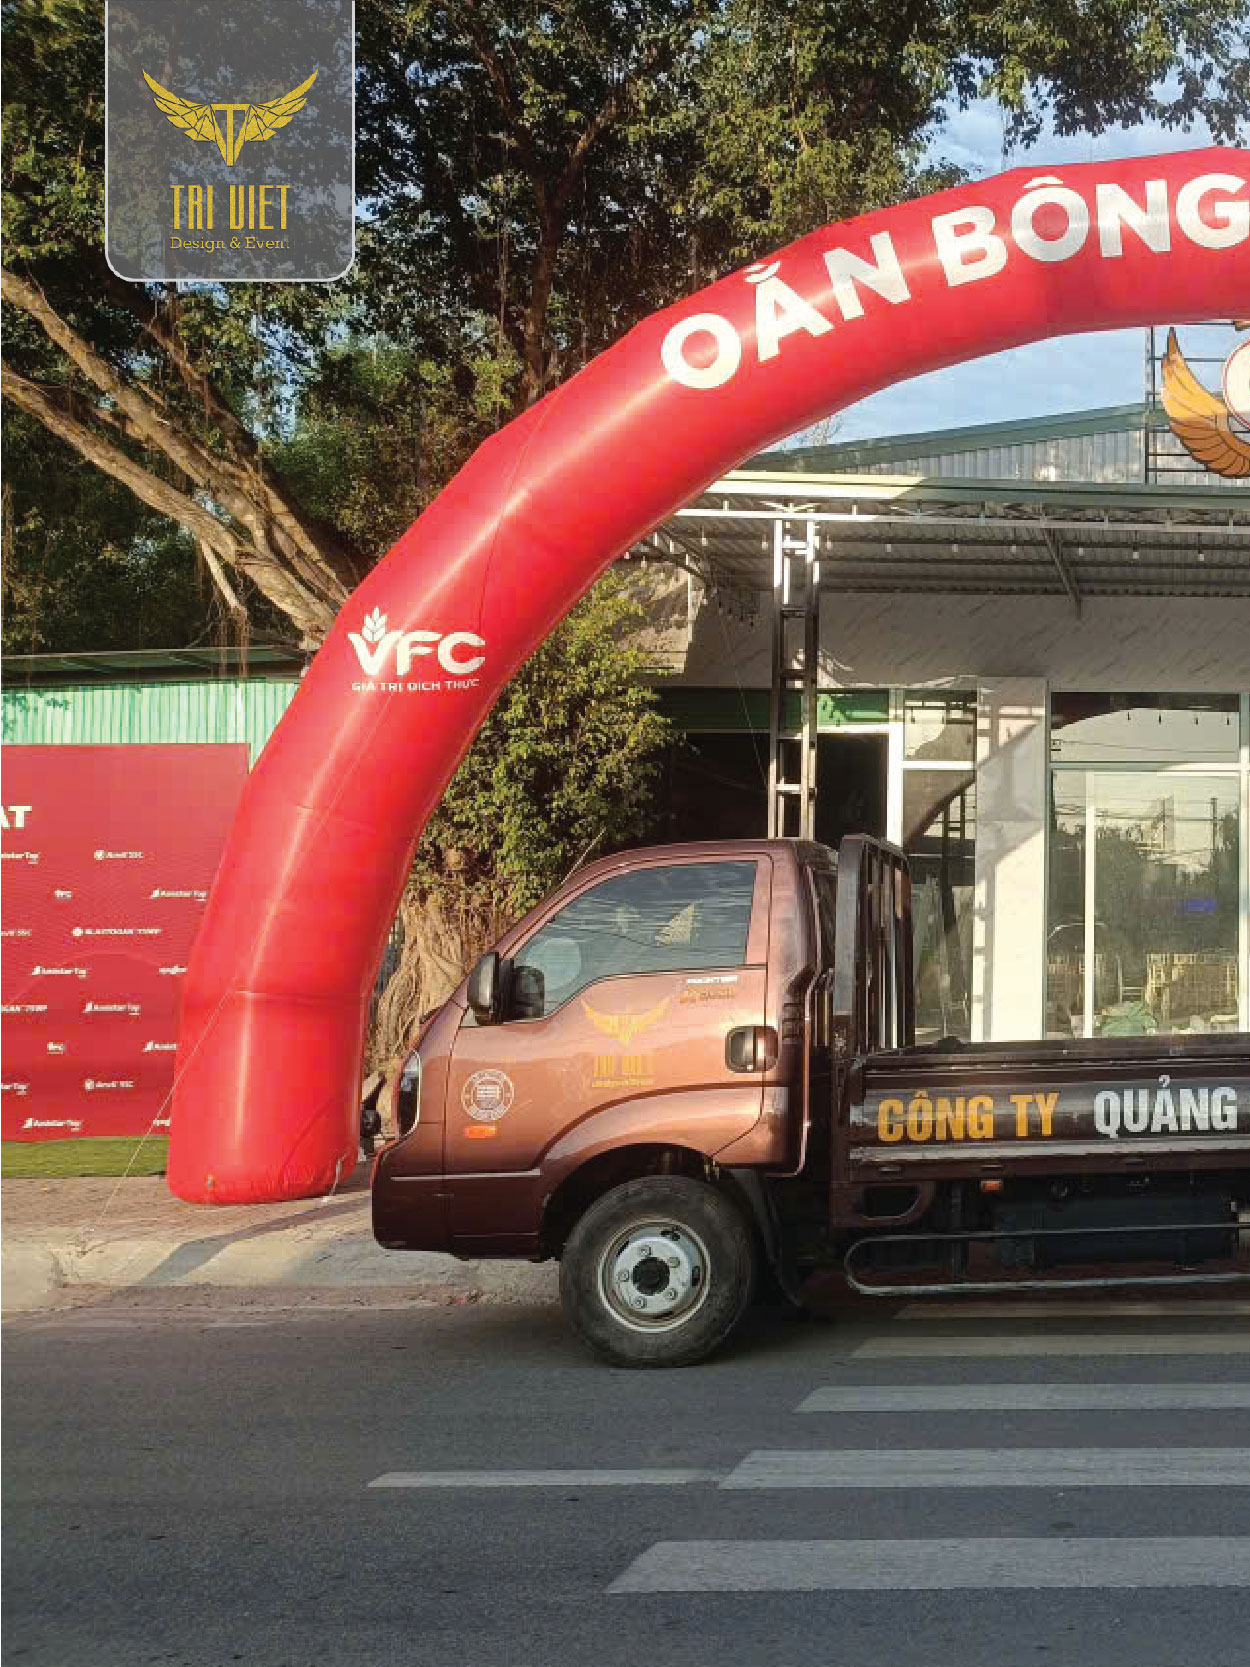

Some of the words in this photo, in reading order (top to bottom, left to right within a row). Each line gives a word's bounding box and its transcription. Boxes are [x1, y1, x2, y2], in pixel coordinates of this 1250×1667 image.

[931, 173, 1250, 287] BÔNG
[347, 631, 486, 676] VFC
[877, 1088, 994, 1142] CÔNG
[1010, 1092, 1060, 1137] TY
[1094, 1075, 1239, 1138] QUẢNG
